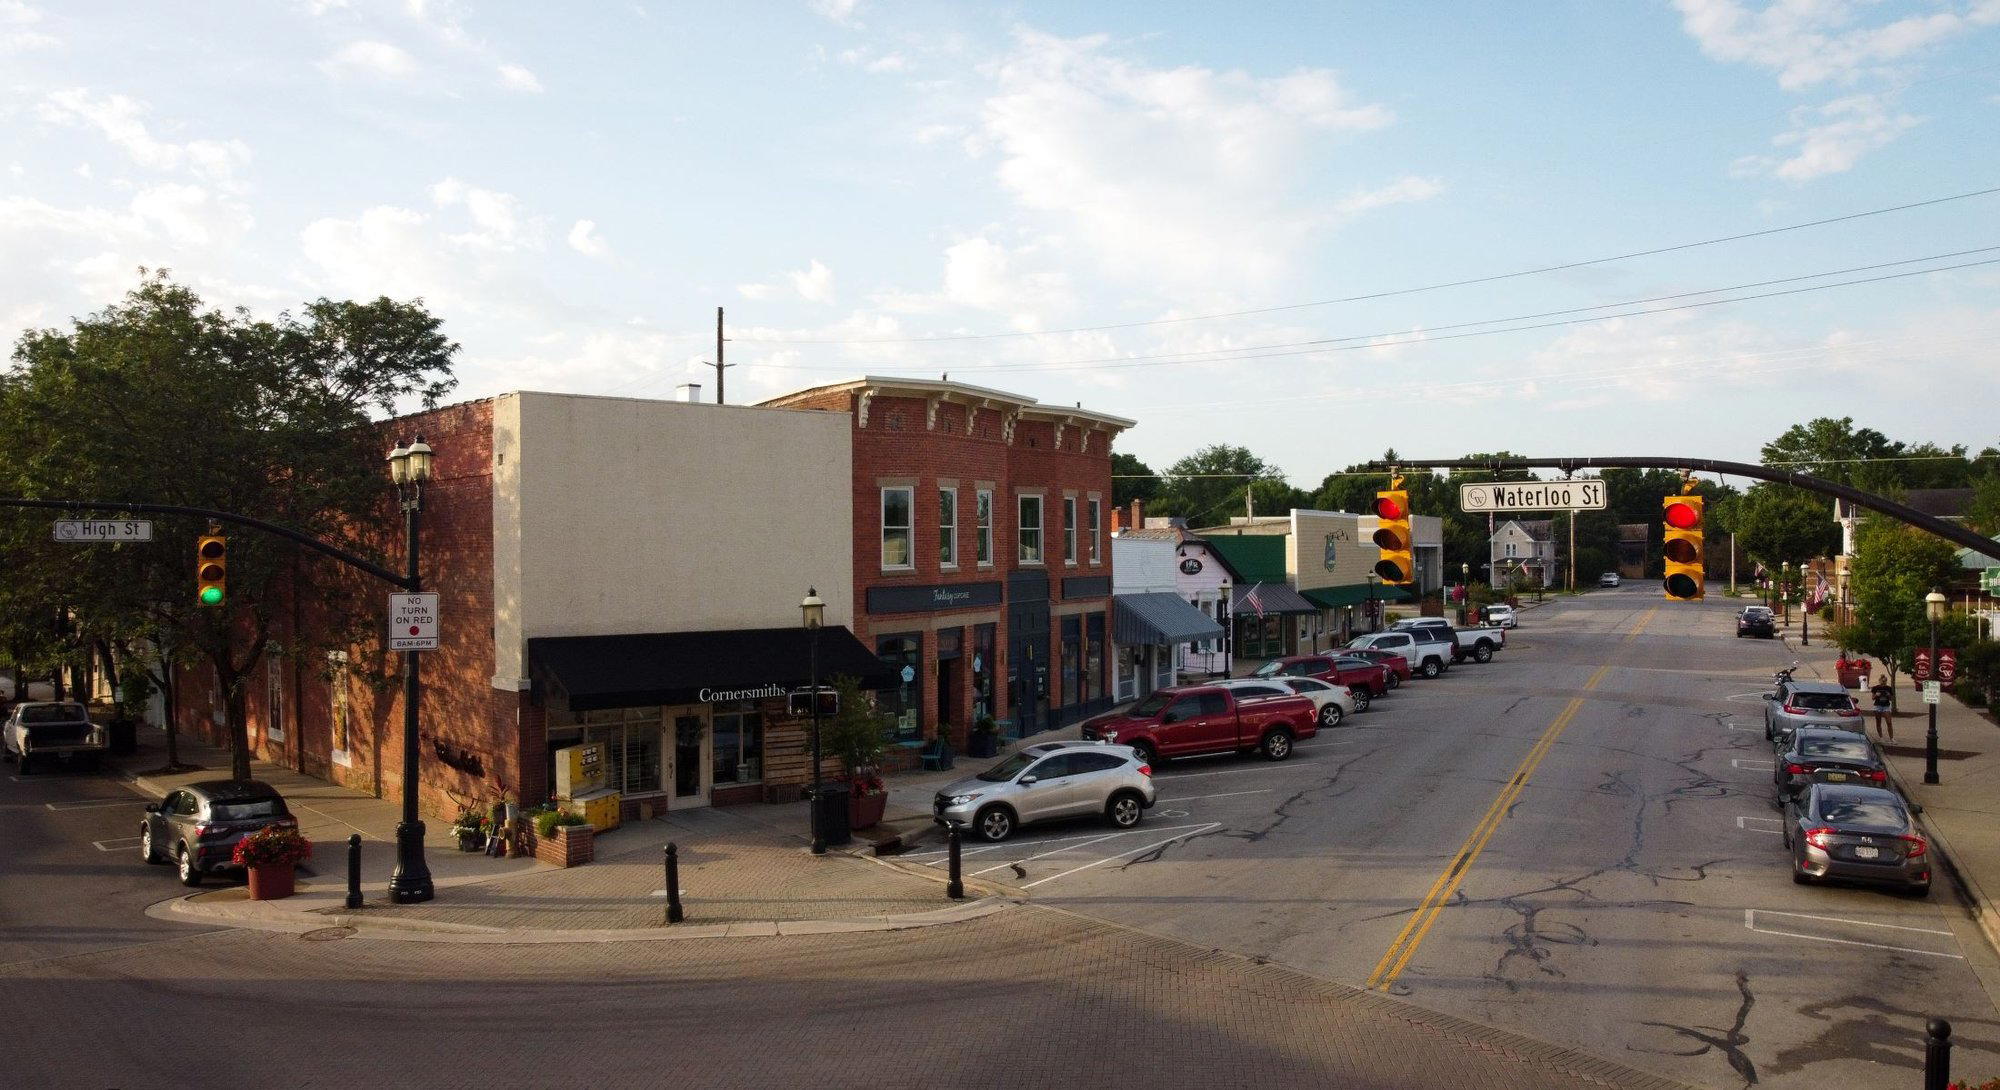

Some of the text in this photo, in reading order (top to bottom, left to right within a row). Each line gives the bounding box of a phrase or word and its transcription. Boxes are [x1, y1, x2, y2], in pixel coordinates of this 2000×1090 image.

[1493, 485, 1599, 507] Waterloo St
[83, 522, 116, 539] High
[124, 522, 140, 535] St
[407, 597, 422, 605] NO
[401, 606, 428, 615] TURN
[395, 616, 433, 624] ON RED
[699, 683, 786, 702] Cornersmiths
